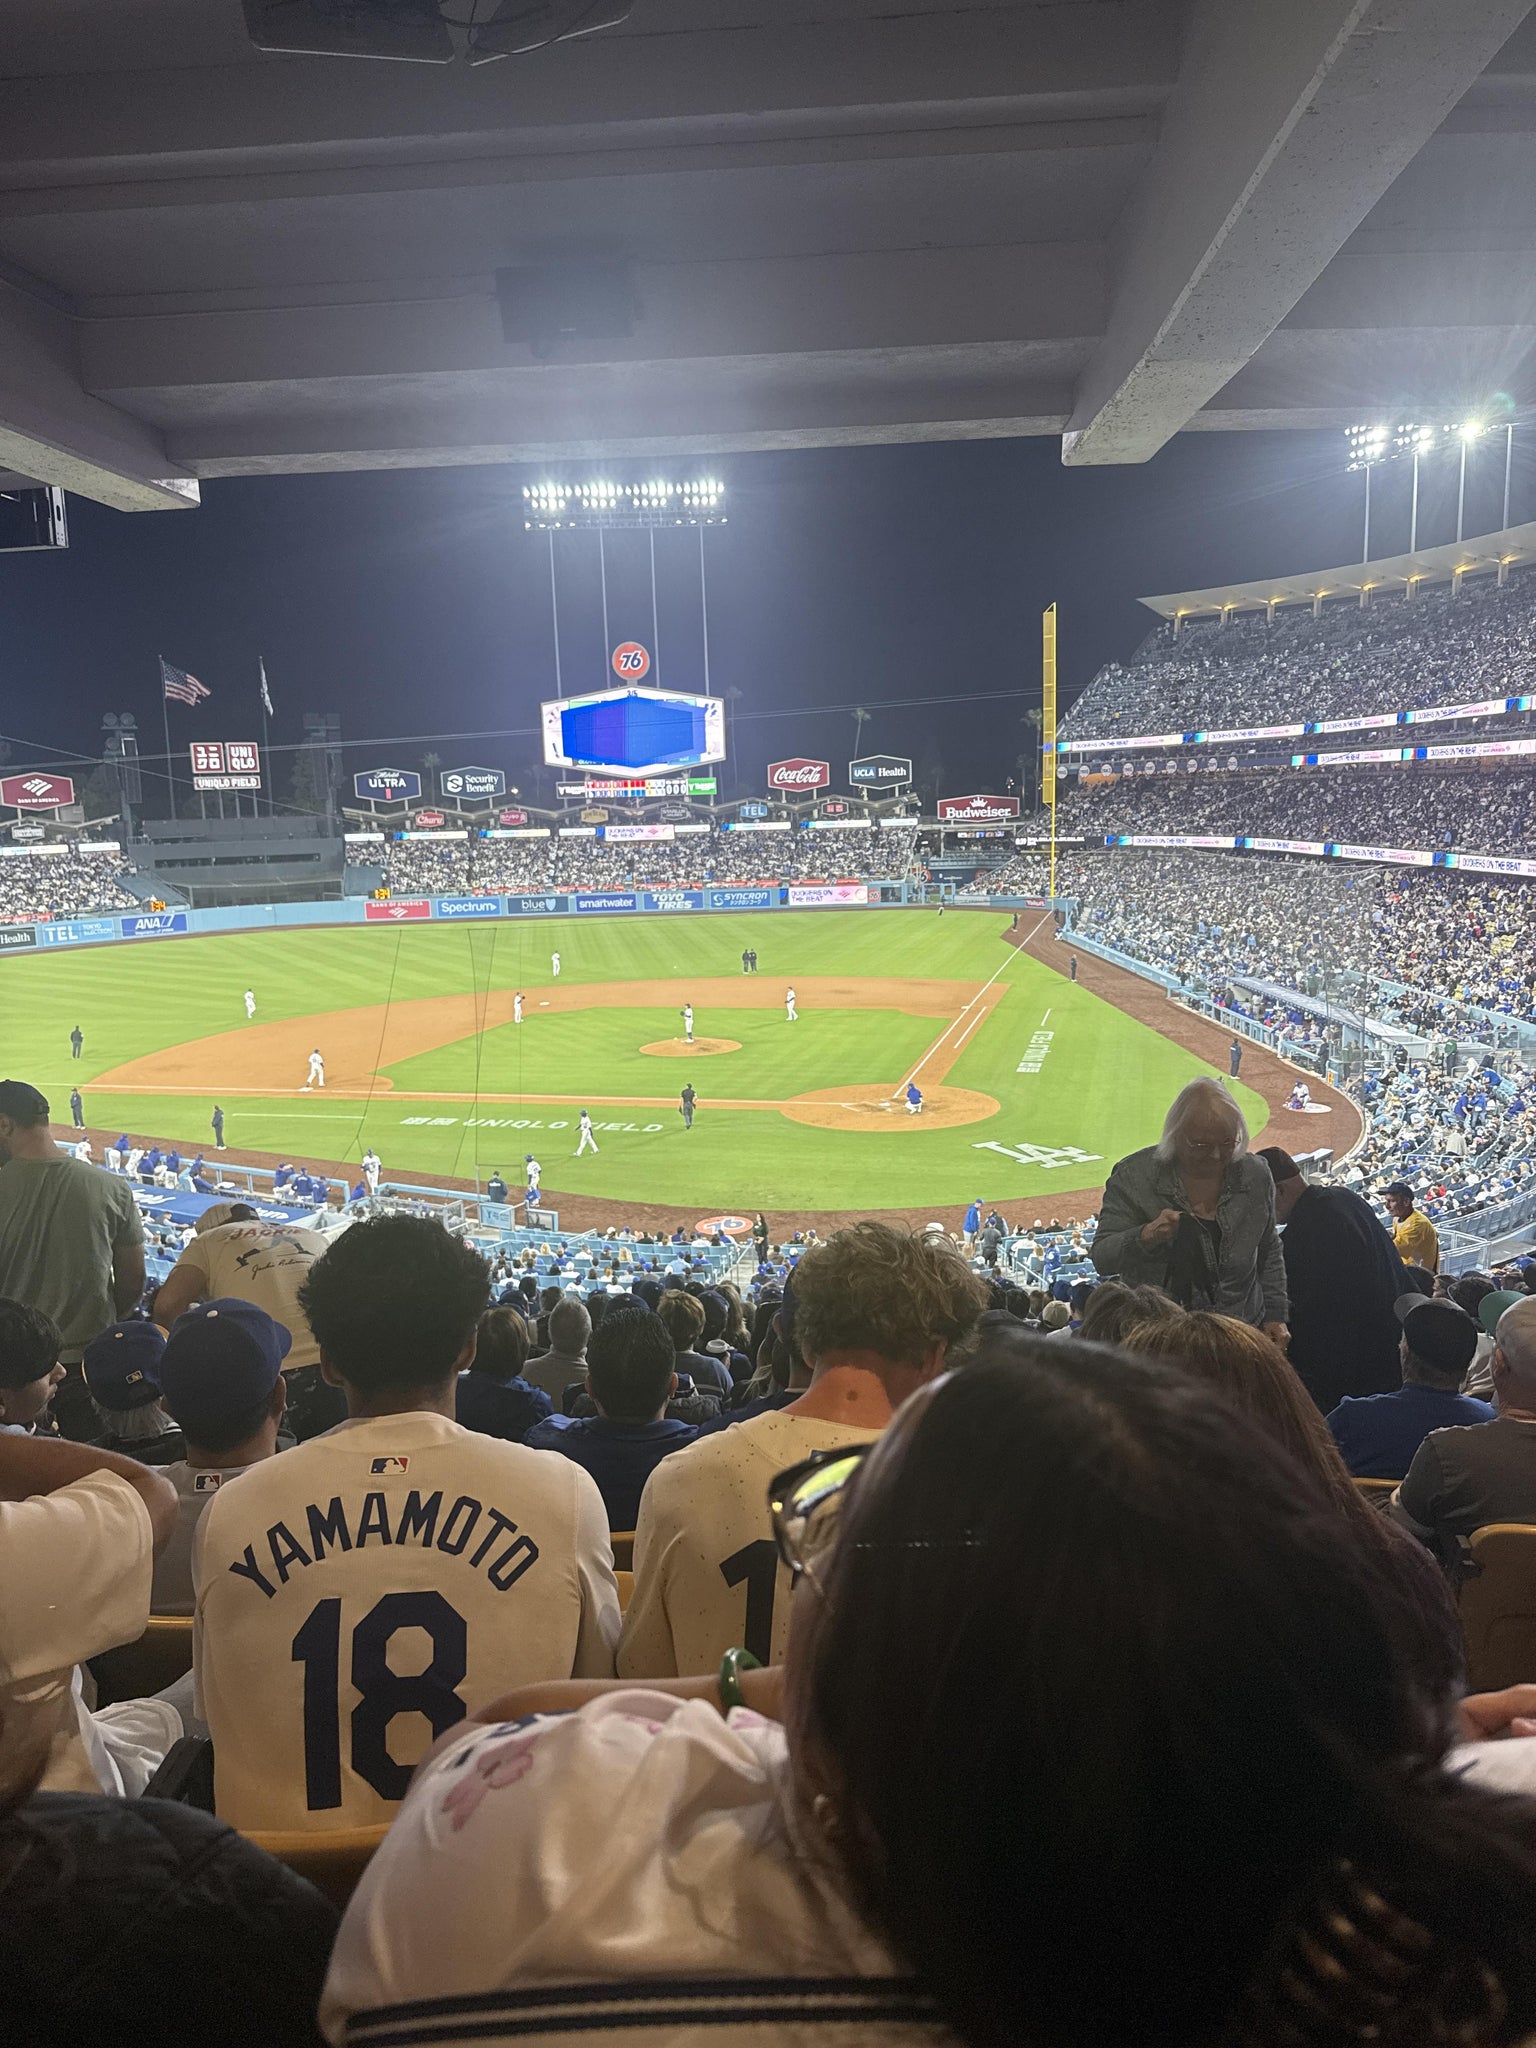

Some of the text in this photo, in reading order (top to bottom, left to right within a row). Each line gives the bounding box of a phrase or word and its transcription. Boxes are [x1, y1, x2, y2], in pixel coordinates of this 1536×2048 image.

[620, 651, 644, 670] 76
[230, 746, 253, 758] UNI
[231, 757, 256, 770] QLO
[854, 767, 907, 777] UCLA Health
[198, 778, 257, 789] UNIQLO FIELD
[368, 778, 407, 788] ULTRA
[465, 774, 499, 785] Security
[466, 783, 496, 793] Benefit
[744, 806, 765, 815] TEL
[946, 807, 1012, 819] Budweiser
[652, 893, 685, 901] TOYO
[724, 892, 768, 901] SYNCRON
[441, 902, 493, 914] Spectrum
[521, 899, 545, 909] blue
[579, 898, 634, 909] smartwater
[657, 900, 692, 909] TIRES
[135, 917, 162, 930] ANA
[0, 932, 31, 944] Health
[45, 925, 78, 942] TEL
[462, 1118, 568, 1129] UNIQLO
[229, 1490, 539, 1599] YAMAMOTO
[291, 1590, 467, 1811] 18
